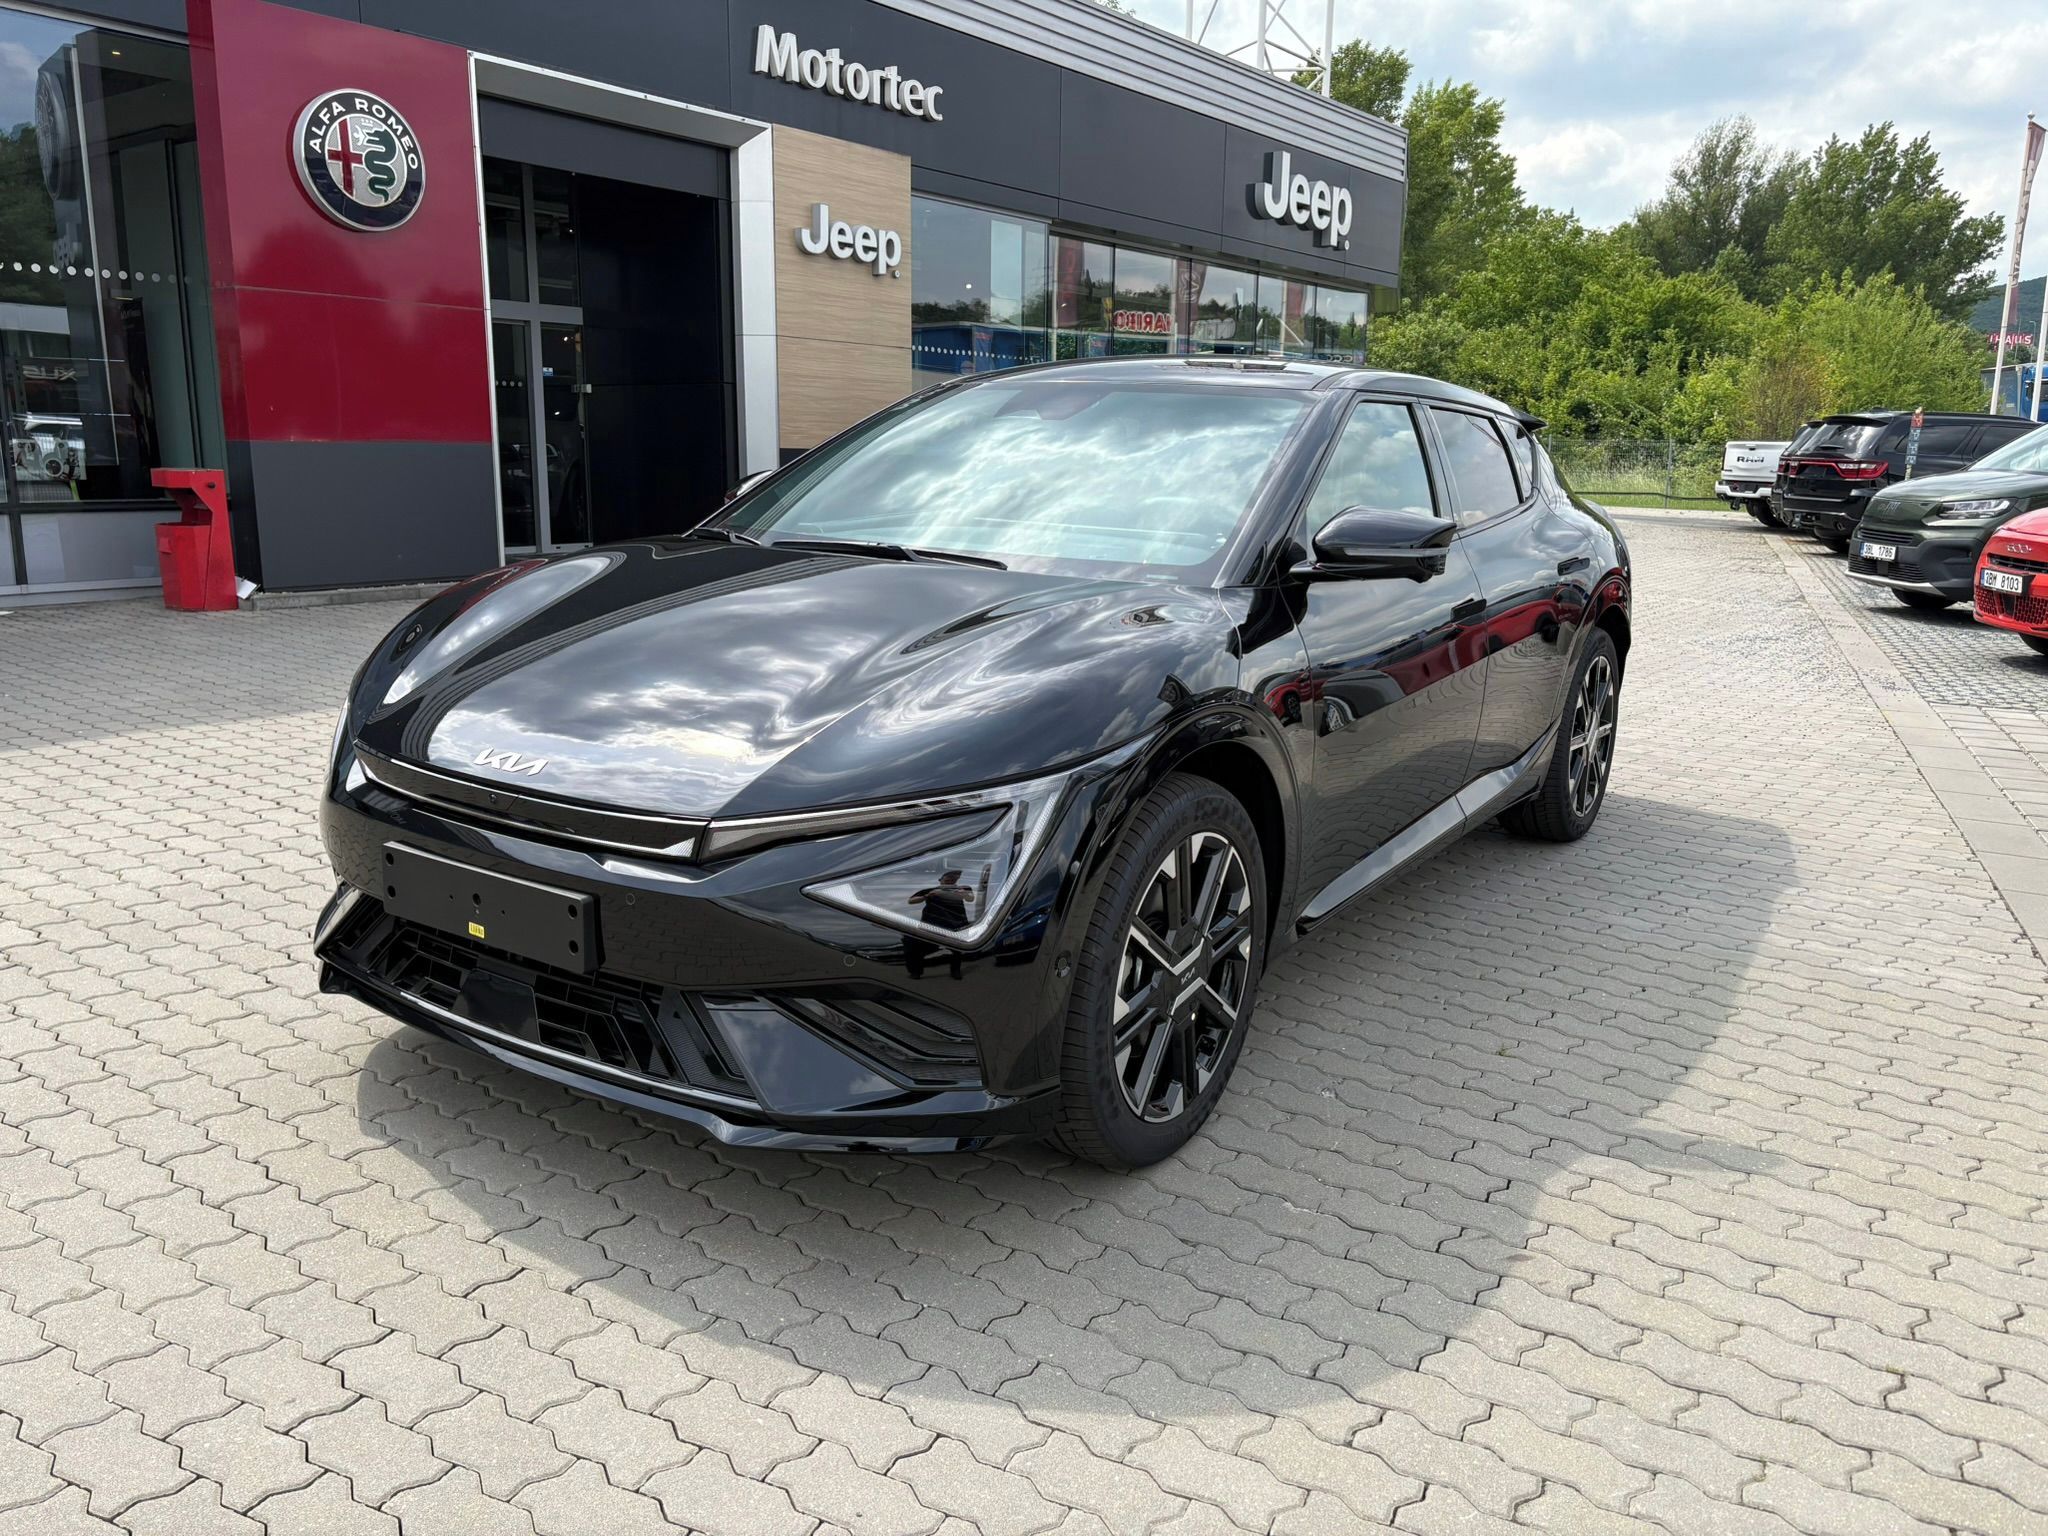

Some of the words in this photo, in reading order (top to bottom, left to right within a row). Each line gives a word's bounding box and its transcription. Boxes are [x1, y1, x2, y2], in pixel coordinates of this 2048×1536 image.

[755, 24, 943, 121] Motortec
[309, 101, 346, 153] ALFA
[355, 98, 418, 169] ROMEO
[1254, 150, 1352, 248] Jeep
[796, 203, 902, 276] Jeep
[2000, 575, 2019, 591] 8103
[473, 747, 549, 777] KIA
